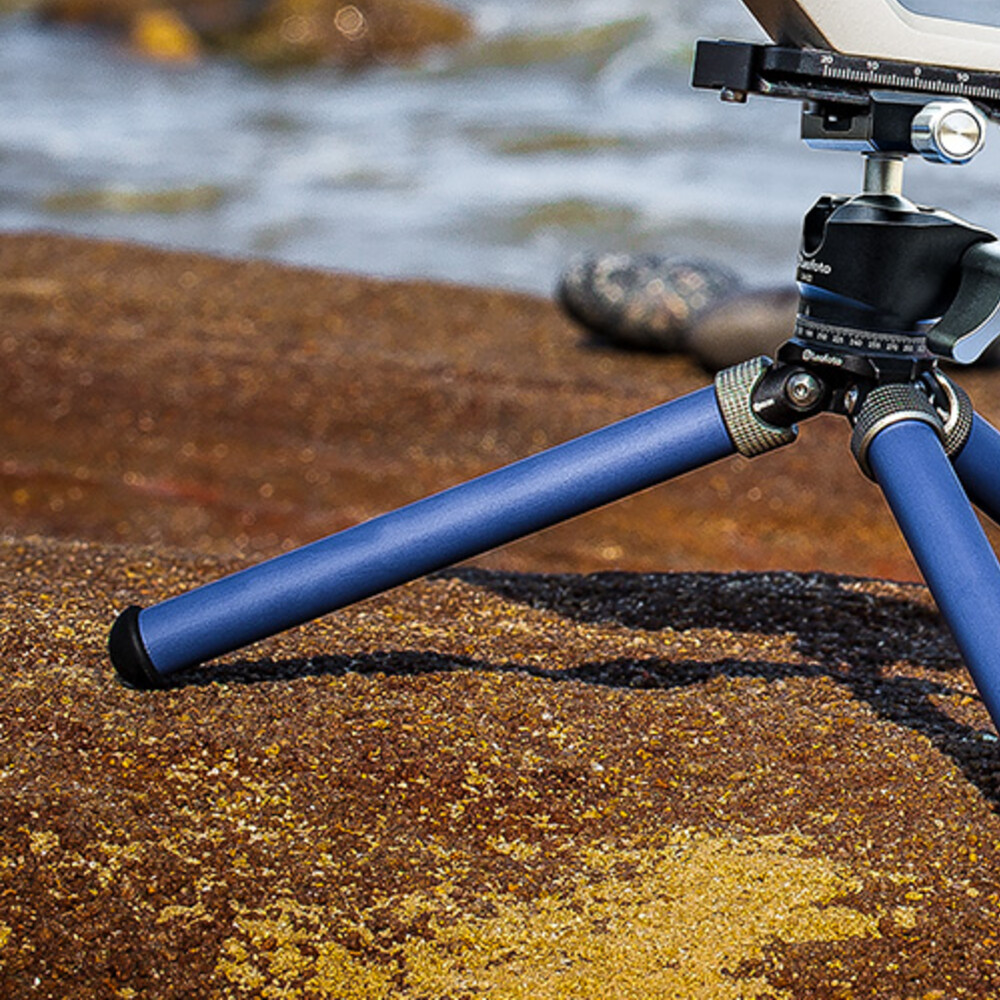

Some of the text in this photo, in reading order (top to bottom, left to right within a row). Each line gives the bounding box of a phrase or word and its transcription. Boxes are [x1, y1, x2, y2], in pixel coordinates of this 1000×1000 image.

[820, 54, 834, 64] 20
[866, 60, 880, 70] 10
[914, 66, 922, 76] 0
[956, 72, 970, 82] 10
